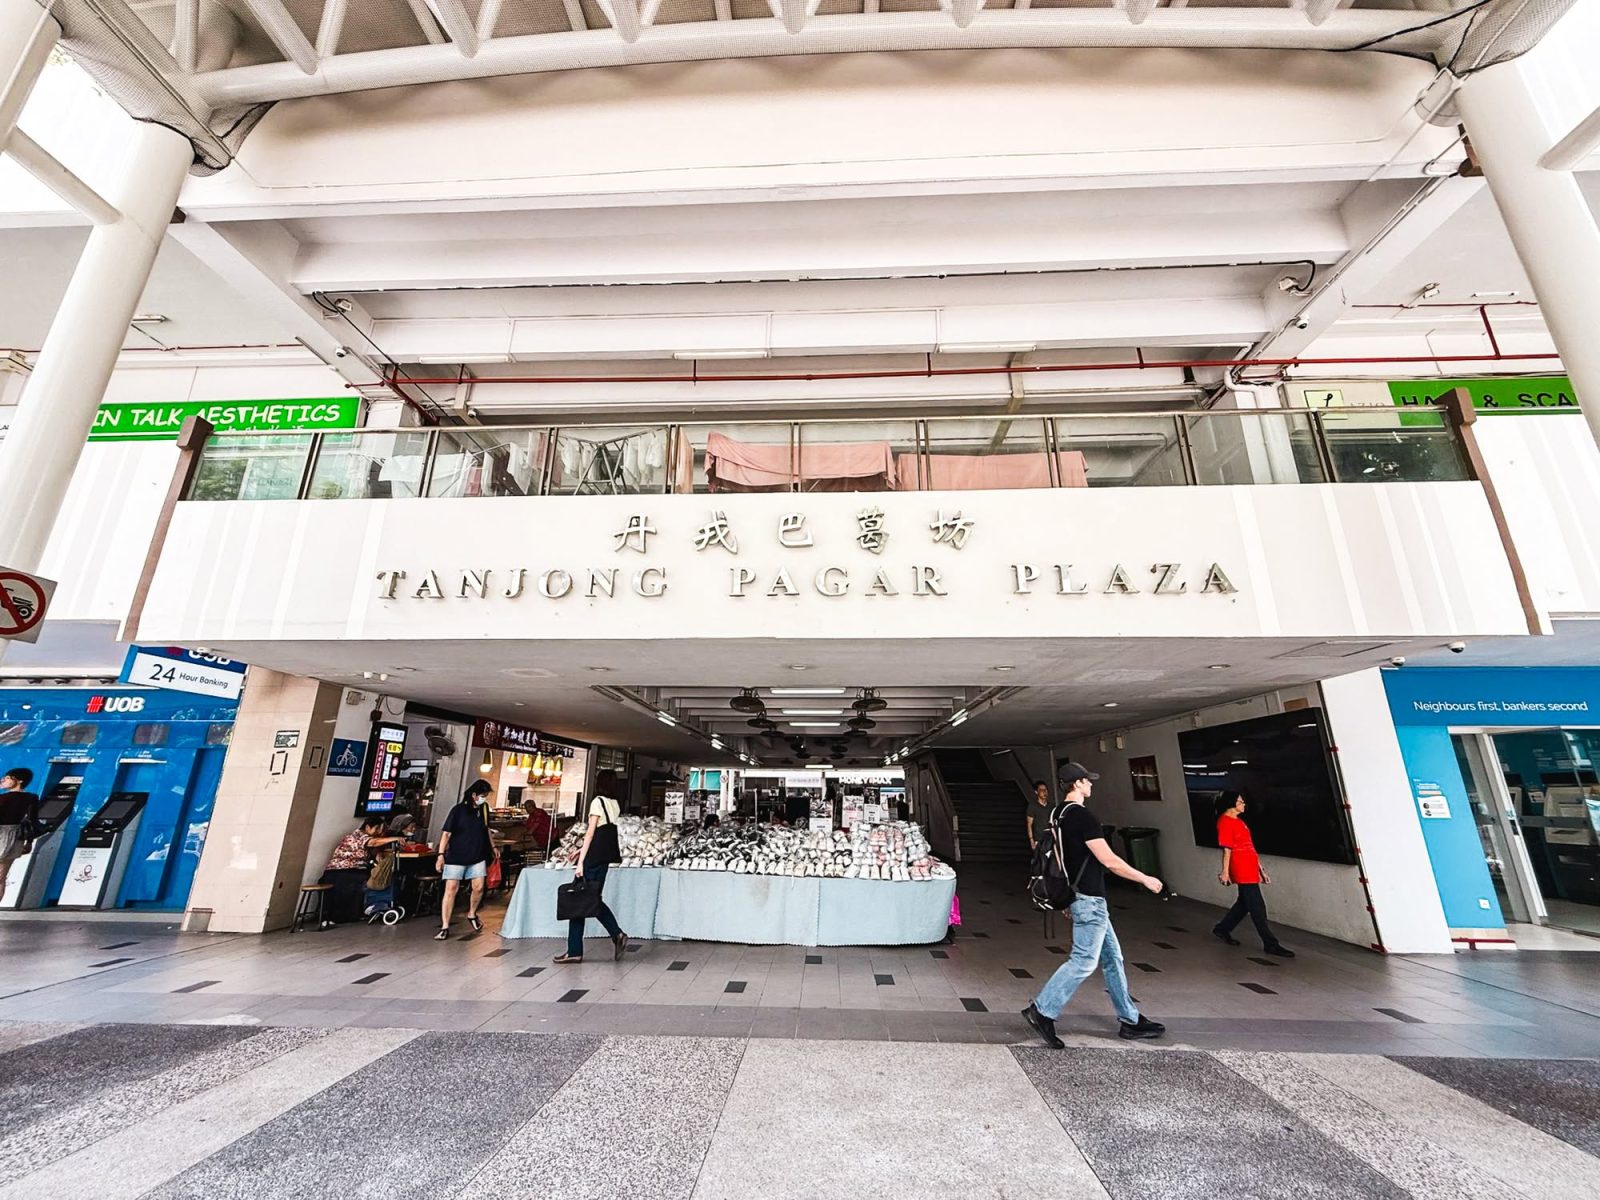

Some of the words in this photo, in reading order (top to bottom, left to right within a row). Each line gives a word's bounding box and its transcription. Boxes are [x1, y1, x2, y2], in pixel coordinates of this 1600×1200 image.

[1483, 394, 1499, 407] &
[1518, 393, 1576, 407] SCA
[130, 408, 184, 426] TALK
[195, 404, 341, 425] AESTHETICS
[614, 507, 975, 554] 丹戎巴葛坊
[376, 567, 669, 601] TANJONG
[729, 565, 949, 598] PAGAR
[1010, 562, 1239, 595] PLAZA
[149, 663, 176, 683] 24
[179, 672, 199, 682] Hour
[199, 677, 229, 689] Banking
[104, 696, 146, 712] UOB
[1414, 701, 1476, 713] Neighbours
[1477, 701, 1501, 711] first,
[1502, 701, 1547, 711] bankers
[1547, 701, 1588, 711] second
